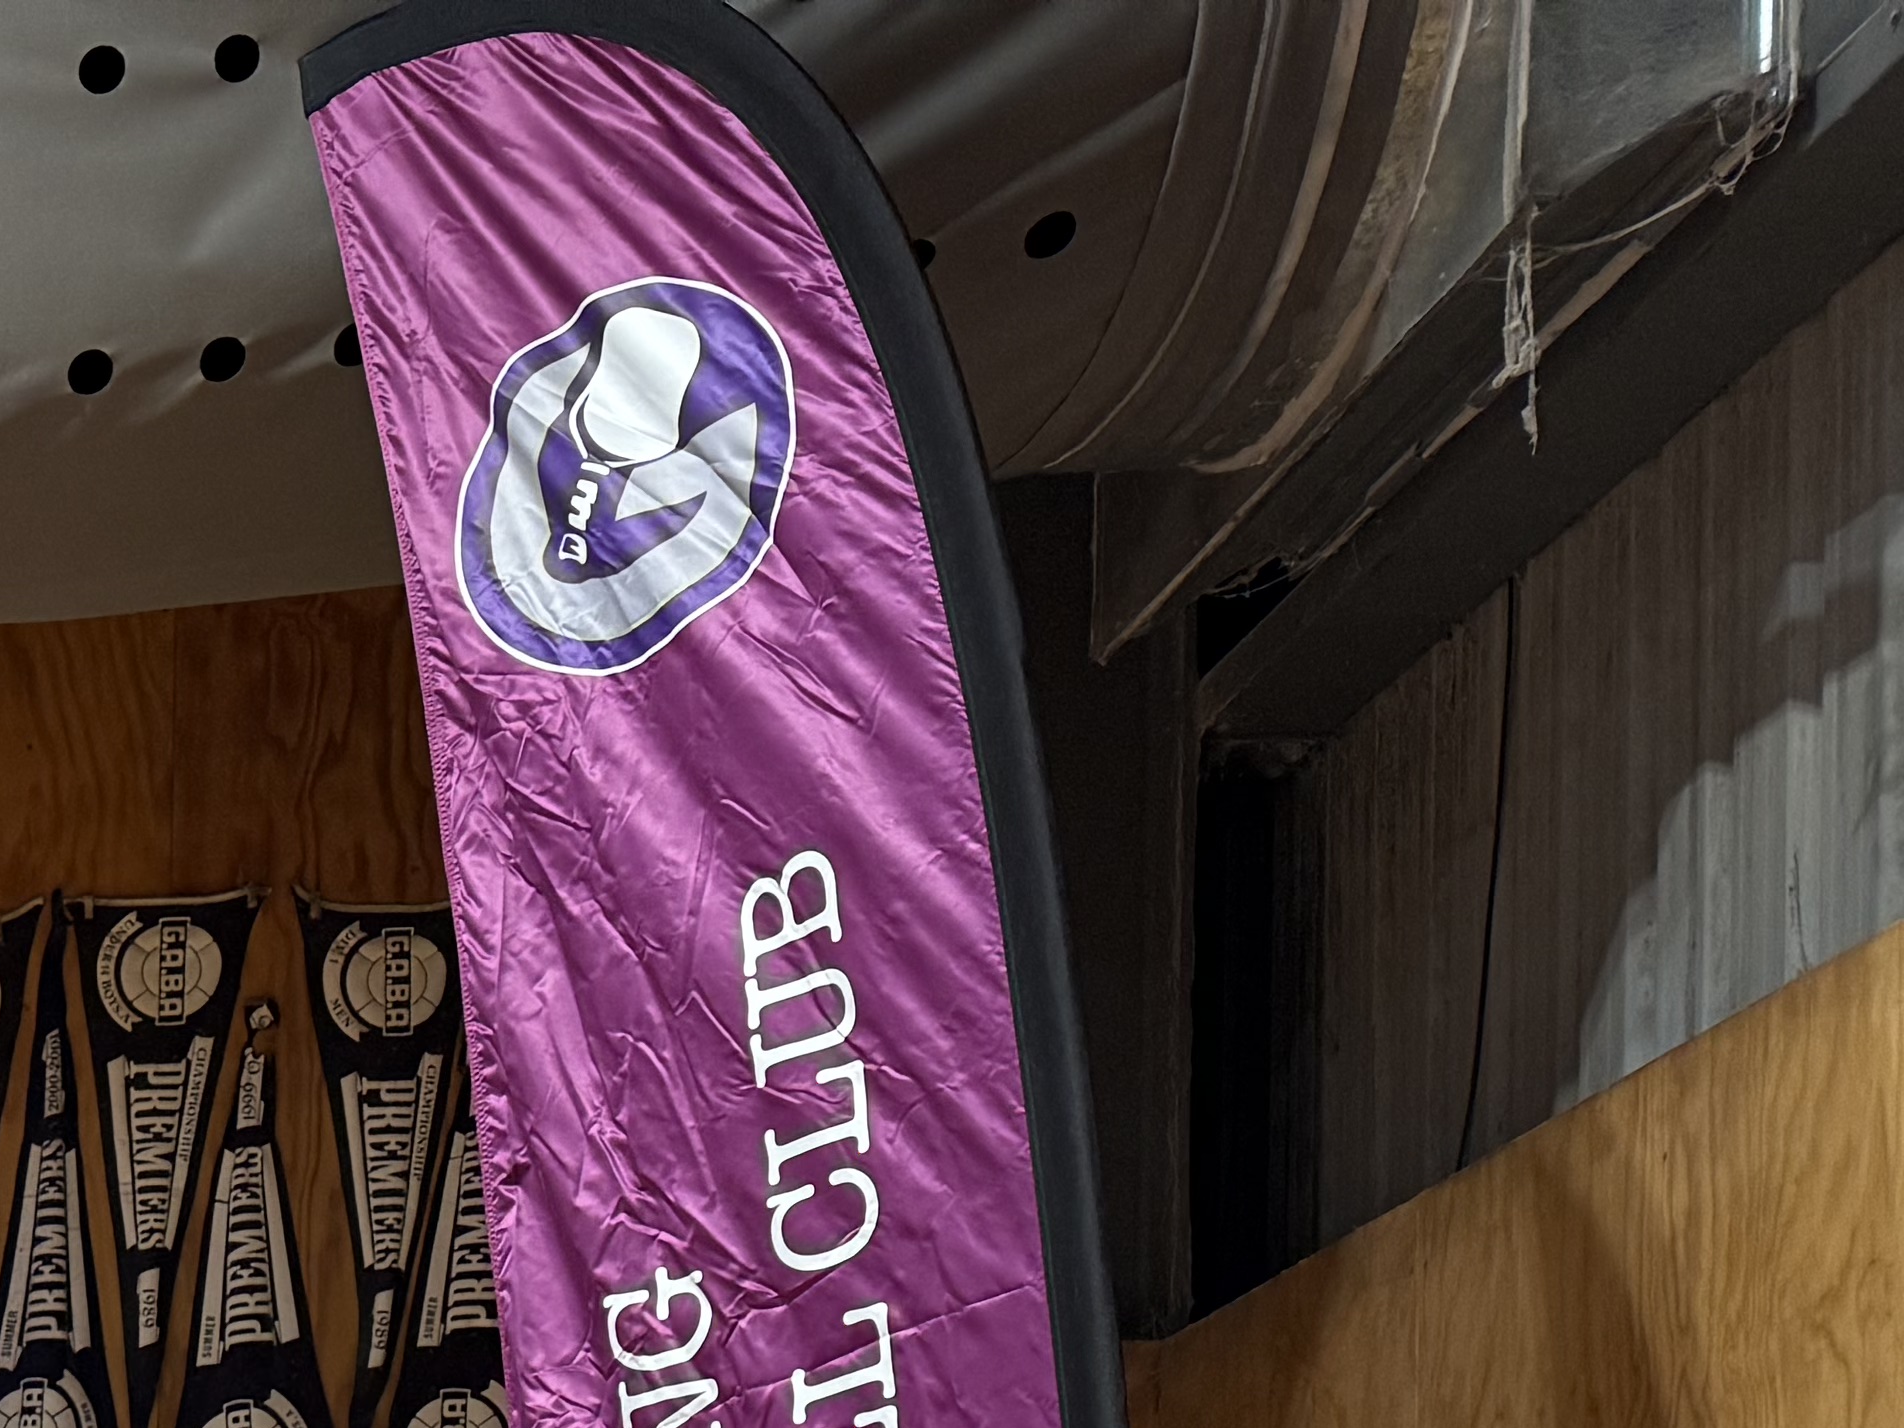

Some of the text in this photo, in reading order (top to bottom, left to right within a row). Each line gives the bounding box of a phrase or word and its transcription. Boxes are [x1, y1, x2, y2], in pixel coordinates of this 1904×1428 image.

[159, 924, 187, 1019] G.A.B.A
[332, 997, 355, 1029] MEN
[385, 934, 411, 1030] G.A.B.A
[178, 1047, 206, 1163] CHAMPIONSHIP
[741, 848, 878, 1270] CLUB
[127, 1059, 182, 1251] PREMIERS
[361, 1076, 416, 1271] PREMIERS
[23, 1138, 71, 1348] PREMIERS
[225, 1146, 277, 1348] PREMIERS
[1, 1309, 18, 1356] SUMMER
[143, 1286, 156, 1331] 1989
[374, 1309, 388, 1351] 1989
